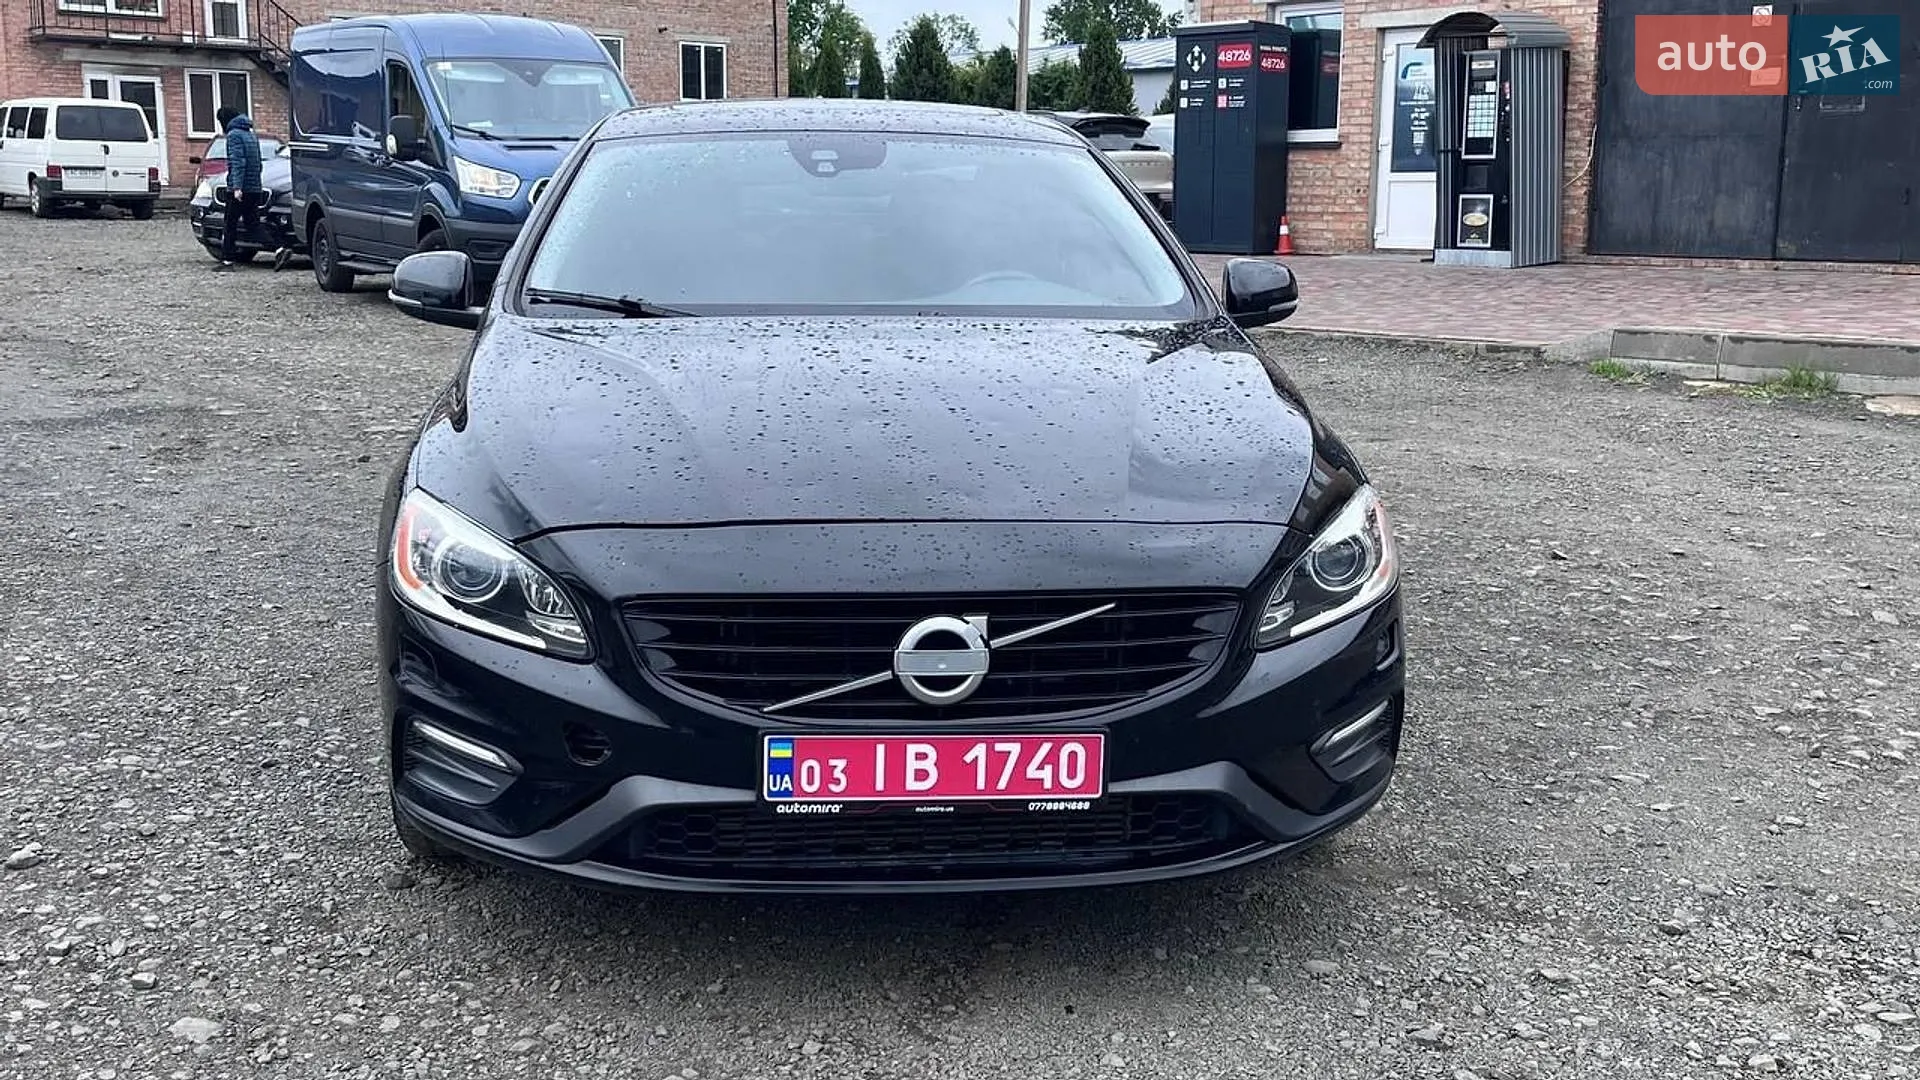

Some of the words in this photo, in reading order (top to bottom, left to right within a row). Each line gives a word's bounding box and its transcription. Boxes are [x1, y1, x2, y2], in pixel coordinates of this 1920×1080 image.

[1218, 51, 1251, 62] 48726
[1261, 57, 1285, 69] 48726
[800, 758, 848, 793] 03
[962, 742, 1087, 791] 1740
[769, 774, 793, 791] UA
[776, 802, 843, 814] automira
